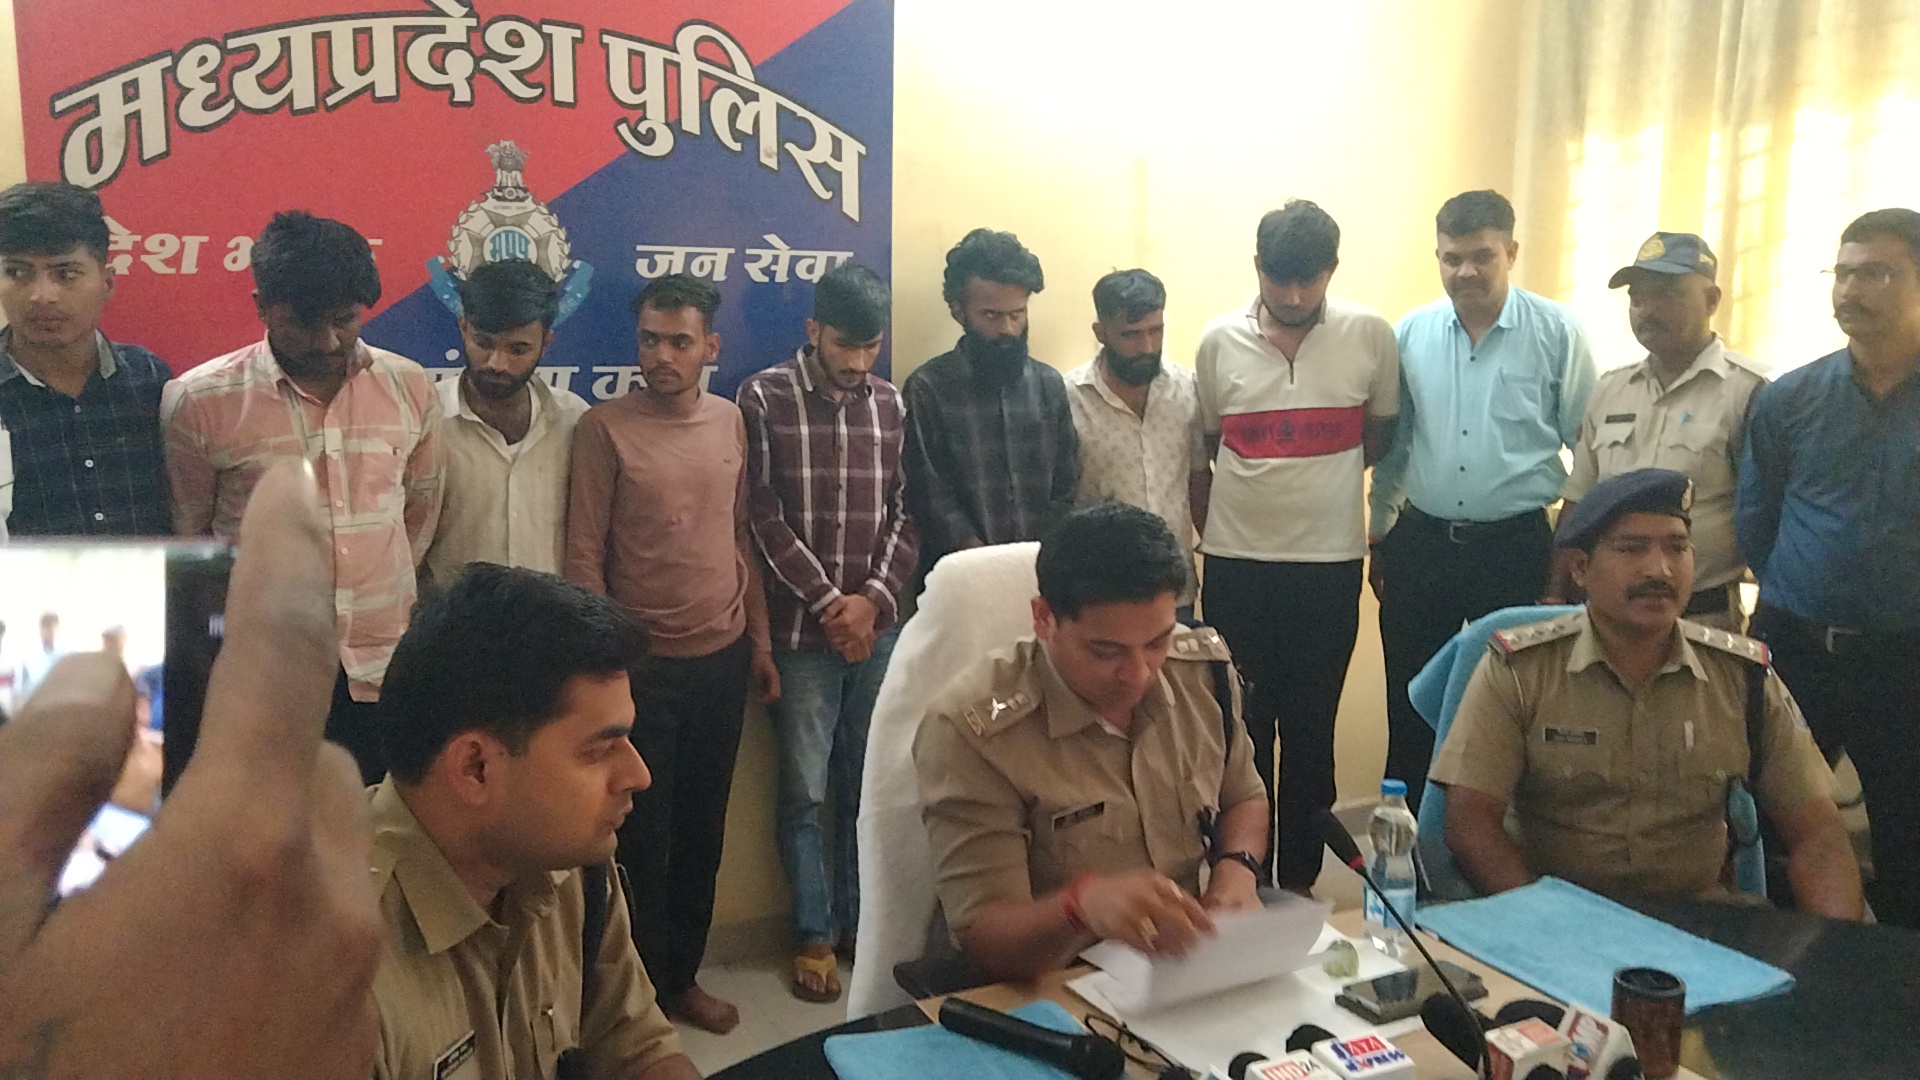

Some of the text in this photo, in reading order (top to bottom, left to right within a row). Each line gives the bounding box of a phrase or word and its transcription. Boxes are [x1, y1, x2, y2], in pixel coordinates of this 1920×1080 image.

[52, 0, 868, 223] मध्यप्रदेश पुलिस
[636, 245, 735, 281] जन
